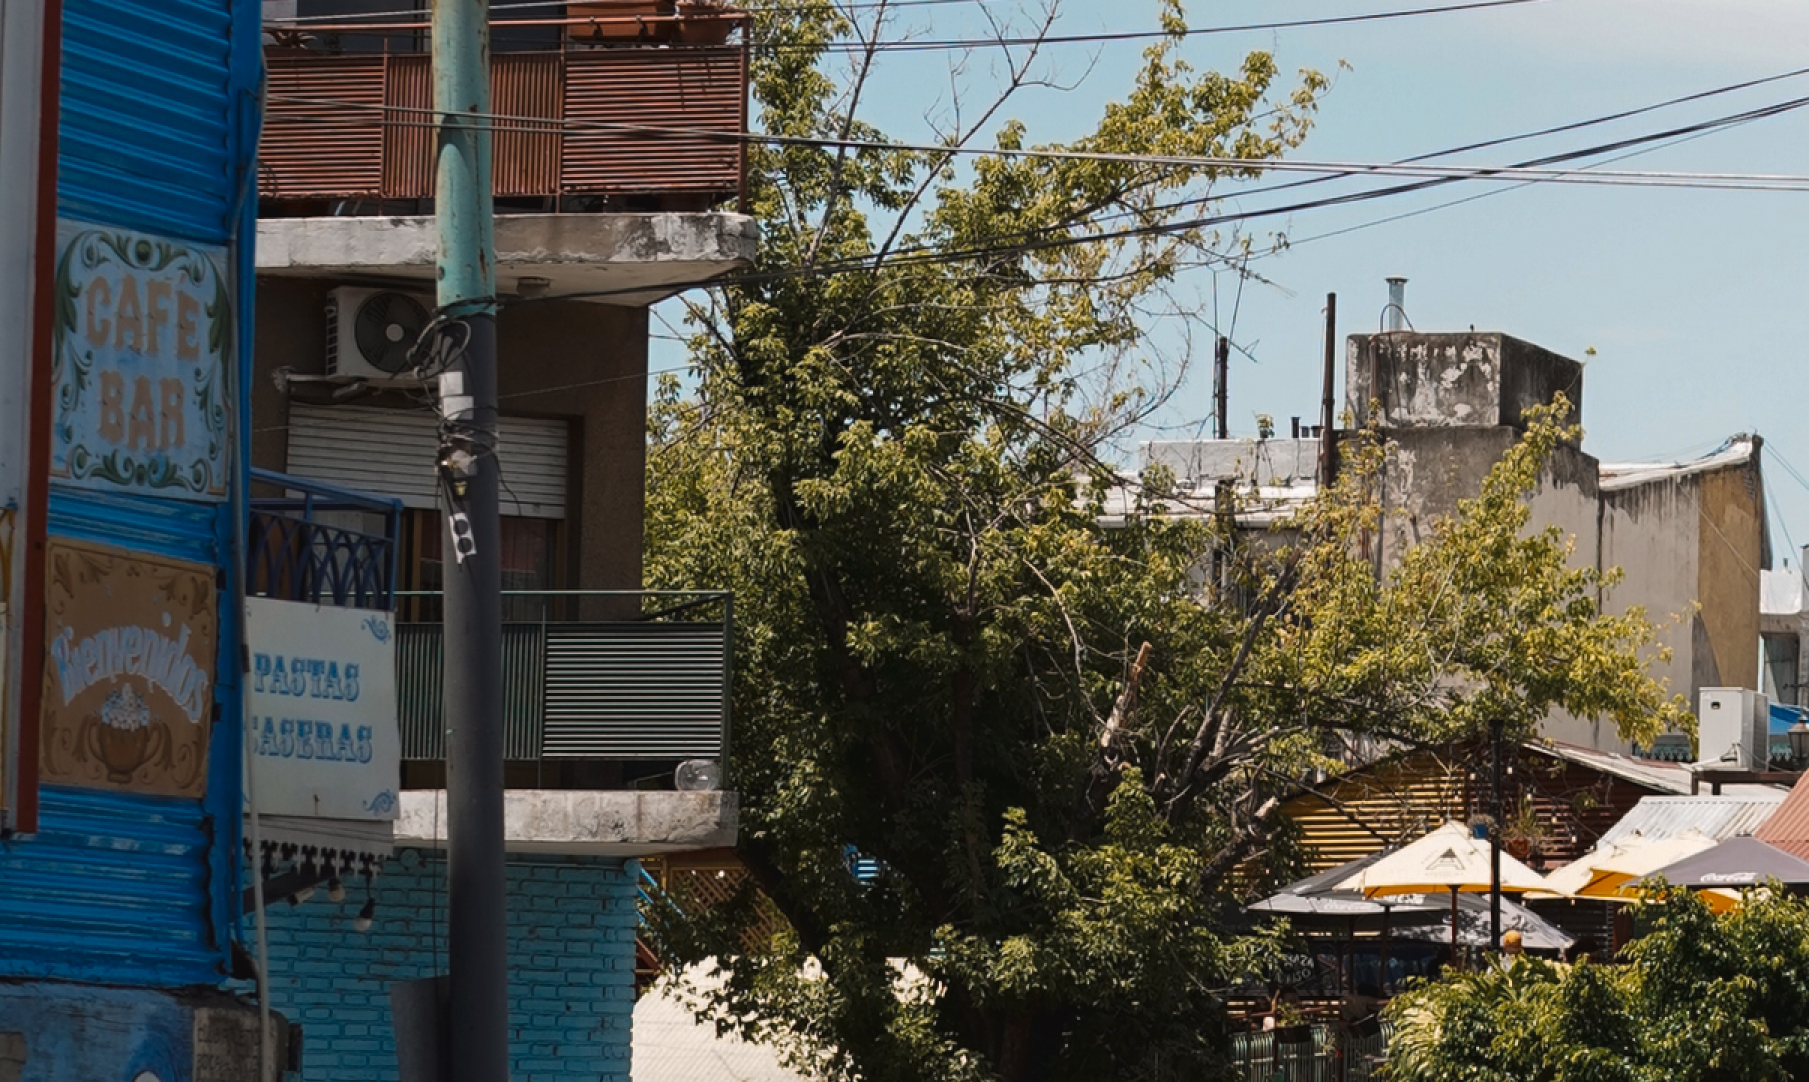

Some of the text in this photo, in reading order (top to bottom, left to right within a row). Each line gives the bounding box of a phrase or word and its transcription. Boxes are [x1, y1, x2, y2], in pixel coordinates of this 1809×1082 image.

[99, 369, 187, 451] BAR
[51, 611, 209, 724] Bienvenidos
[253, 652, 361, 702] PASTAS
